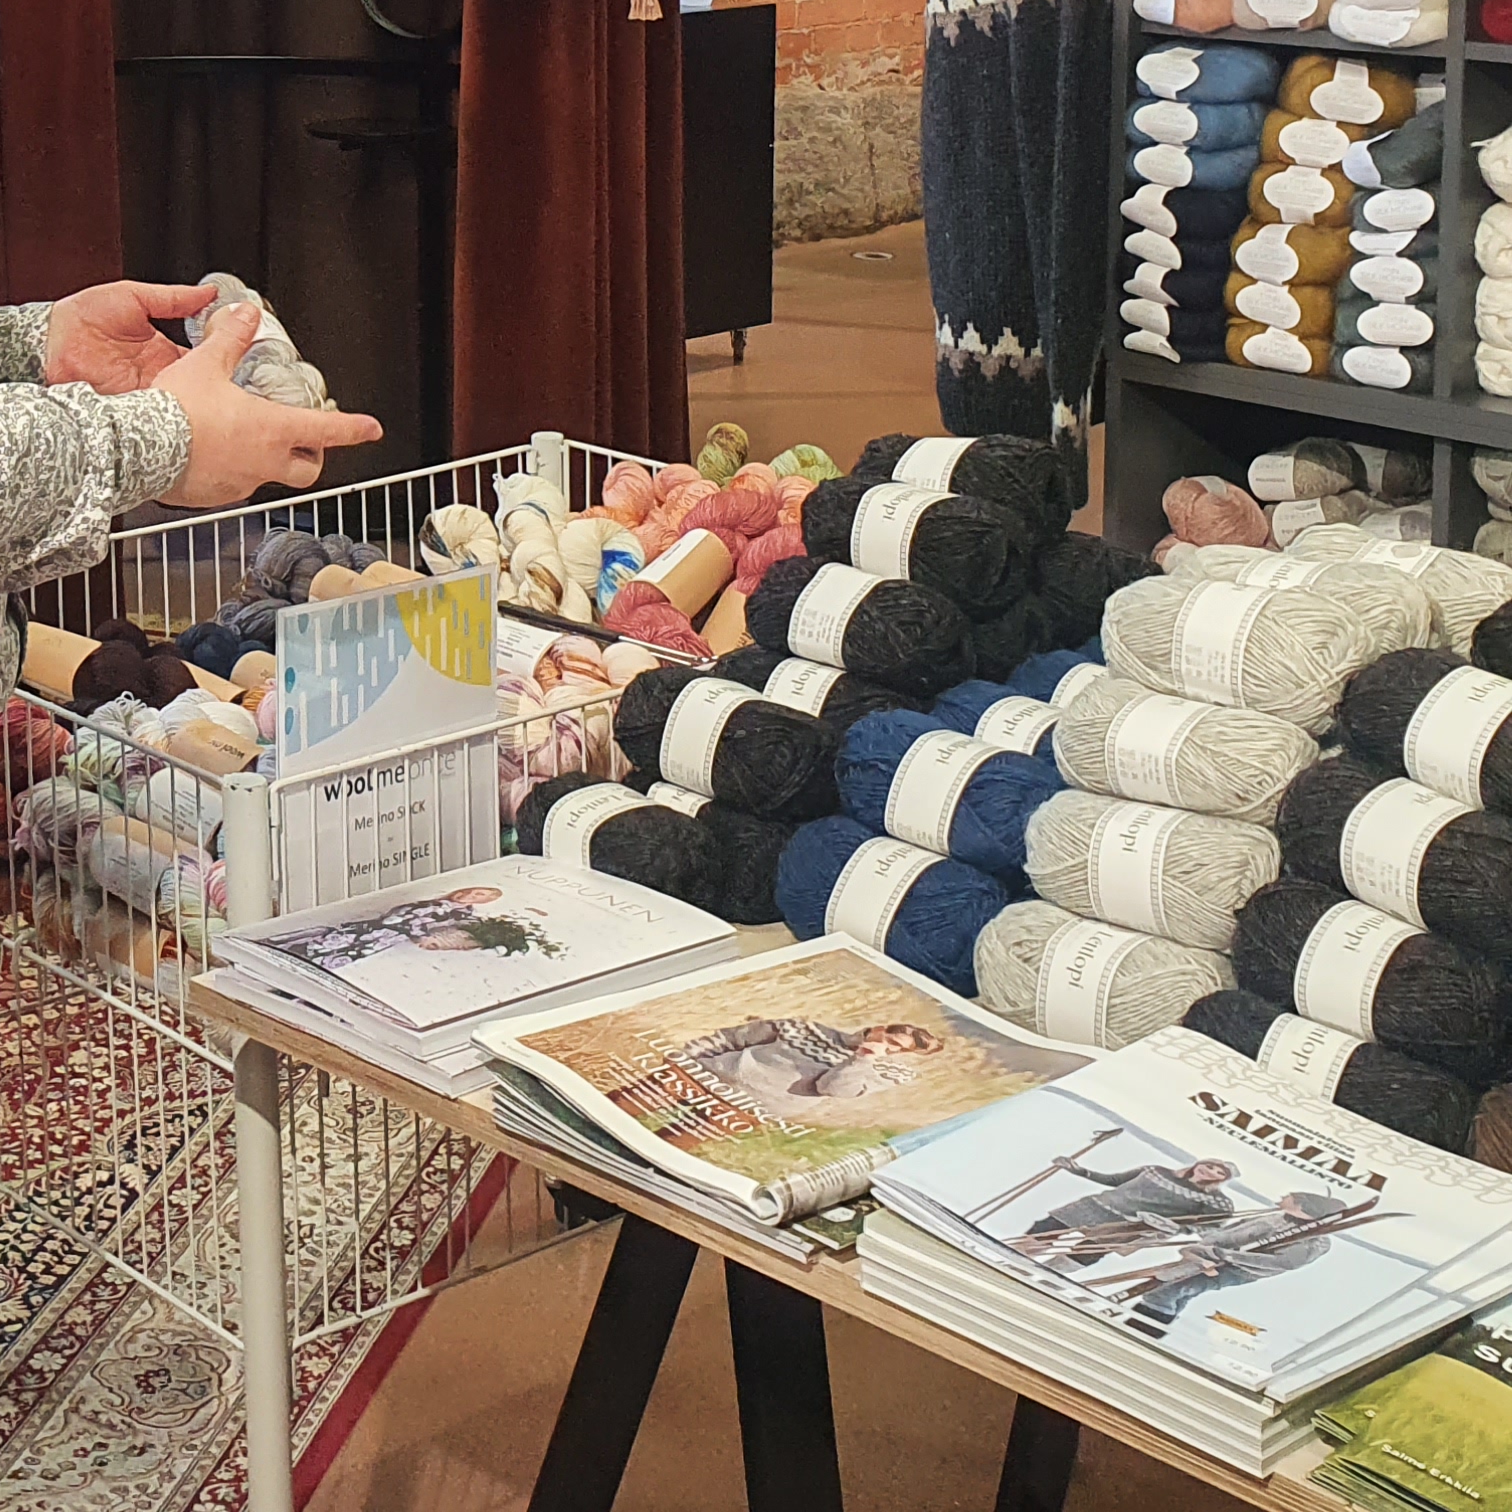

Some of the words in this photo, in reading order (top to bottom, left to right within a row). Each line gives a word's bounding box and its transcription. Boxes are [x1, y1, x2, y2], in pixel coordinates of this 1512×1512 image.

[354, 809, 395, 831] Meino
[397, 799, 426, 819] SCK
[504, 865, 665, 923] NUPPUNEN
[634, 1028, 818, 1138] Luonnollisesti
[1187, 1091, 1388, 1193] SAIMAA
